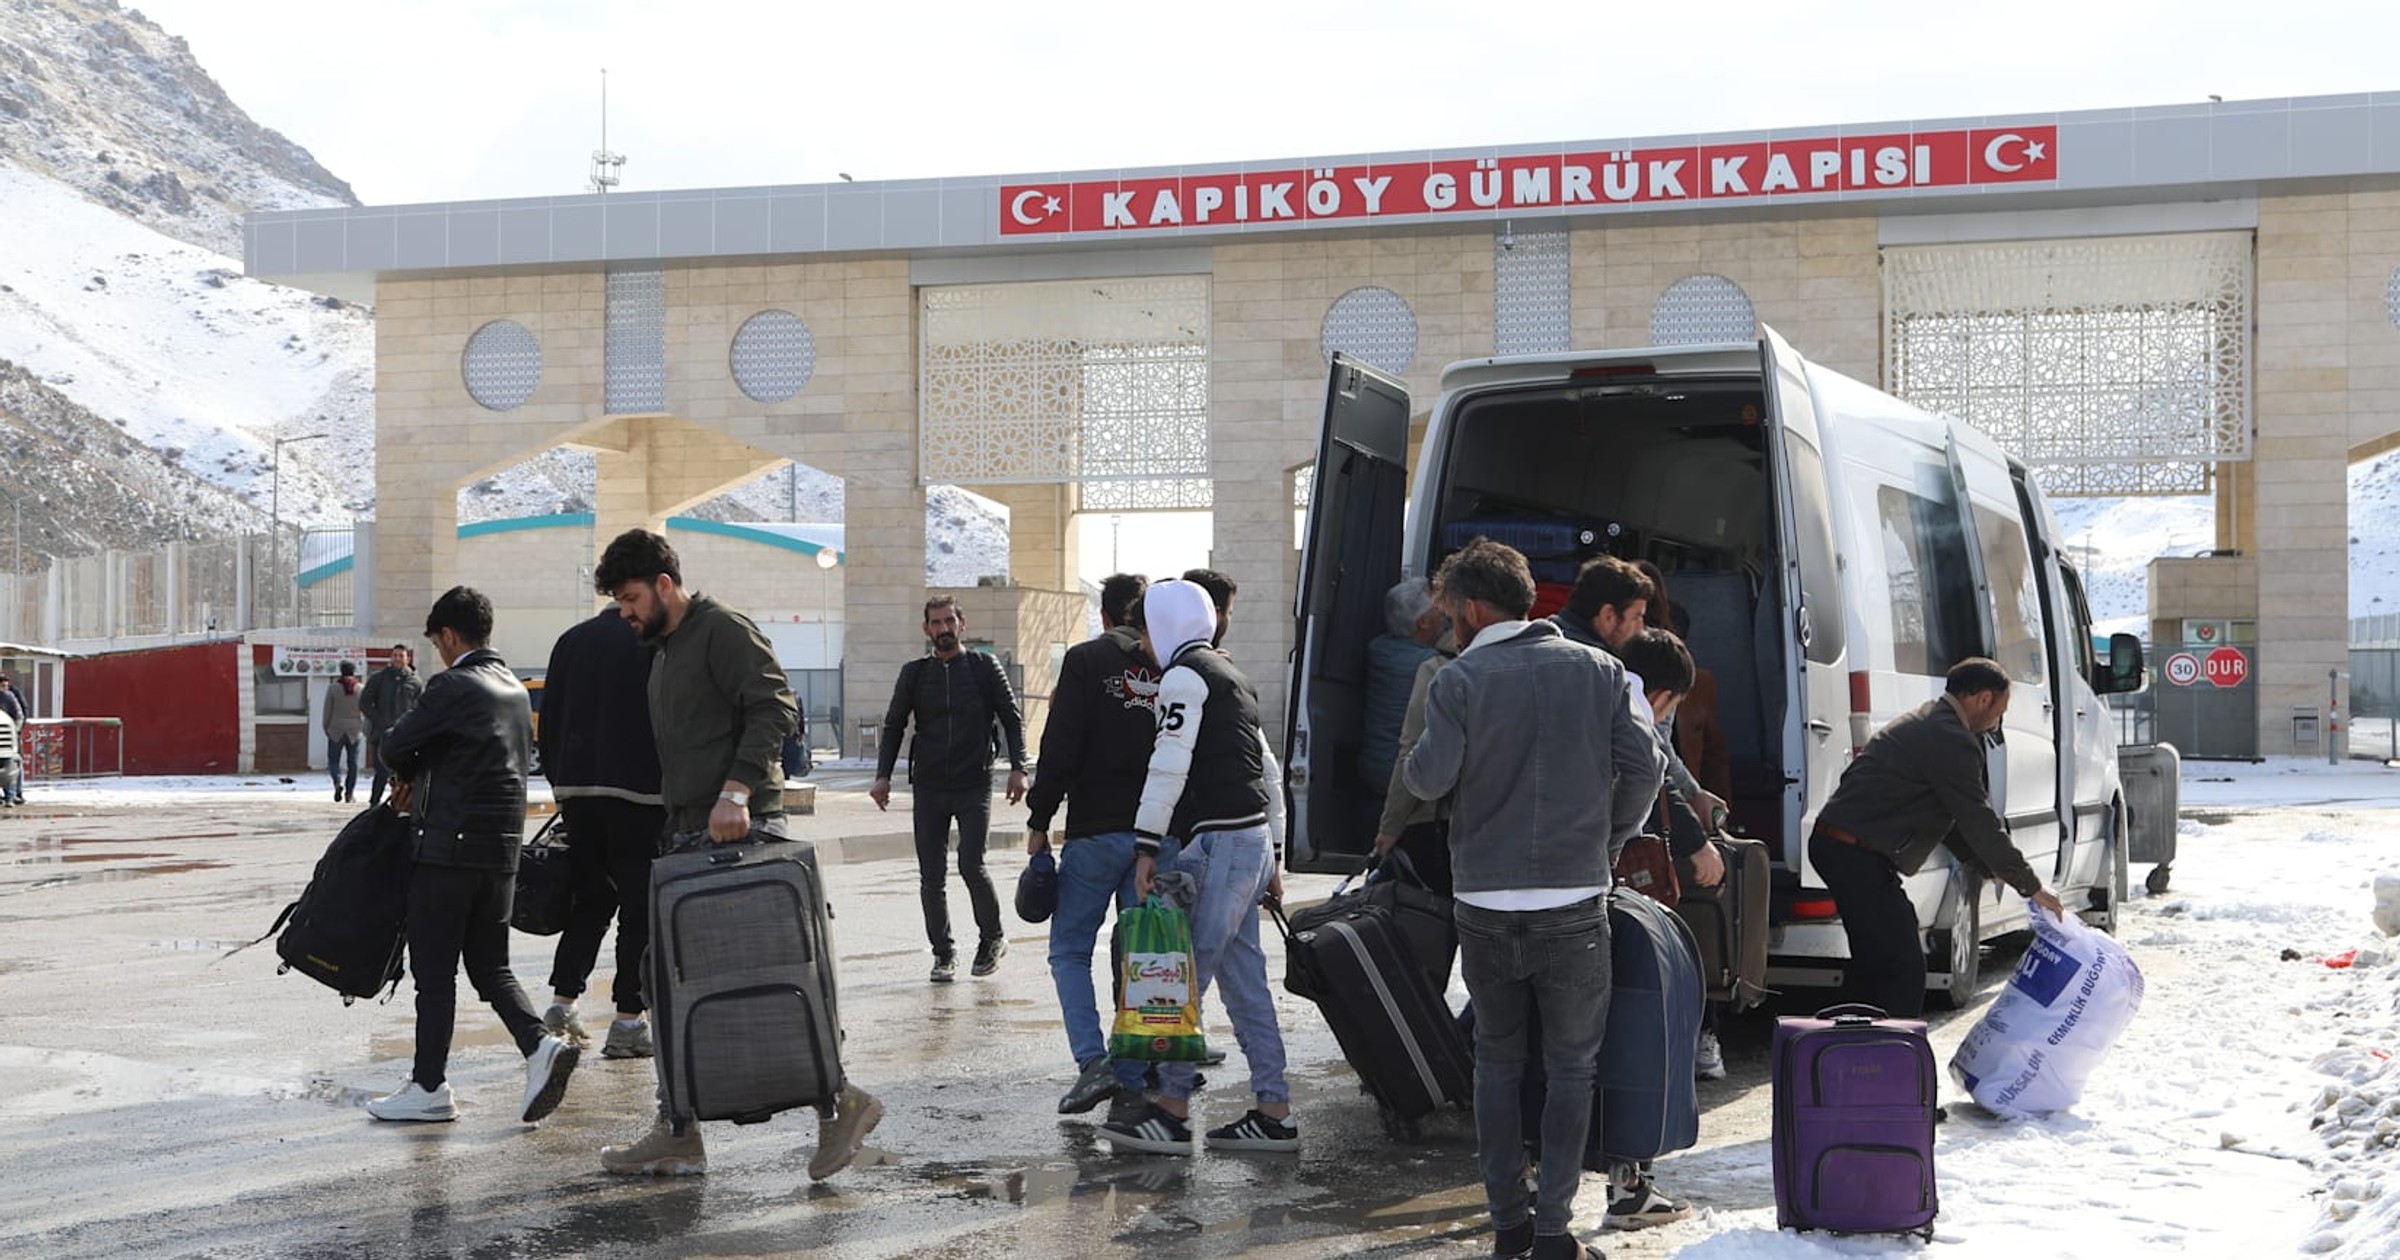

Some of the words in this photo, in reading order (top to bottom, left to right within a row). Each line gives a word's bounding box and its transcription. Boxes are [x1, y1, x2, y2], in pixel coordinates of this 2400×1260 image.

[1103, 170, 1392, 226] KAPIKÖY
[1423, 150, 1686, 209] GÜMRÜK
[1711, 144, 1930, 194] KAPISI
[2173, 664, 2193, 675] 30
[2207, 660, 2244, 675] DUR
[1124, 696, 1157, 714] adida
[2047, 995, 2088, 1046] EKMEKLİK
